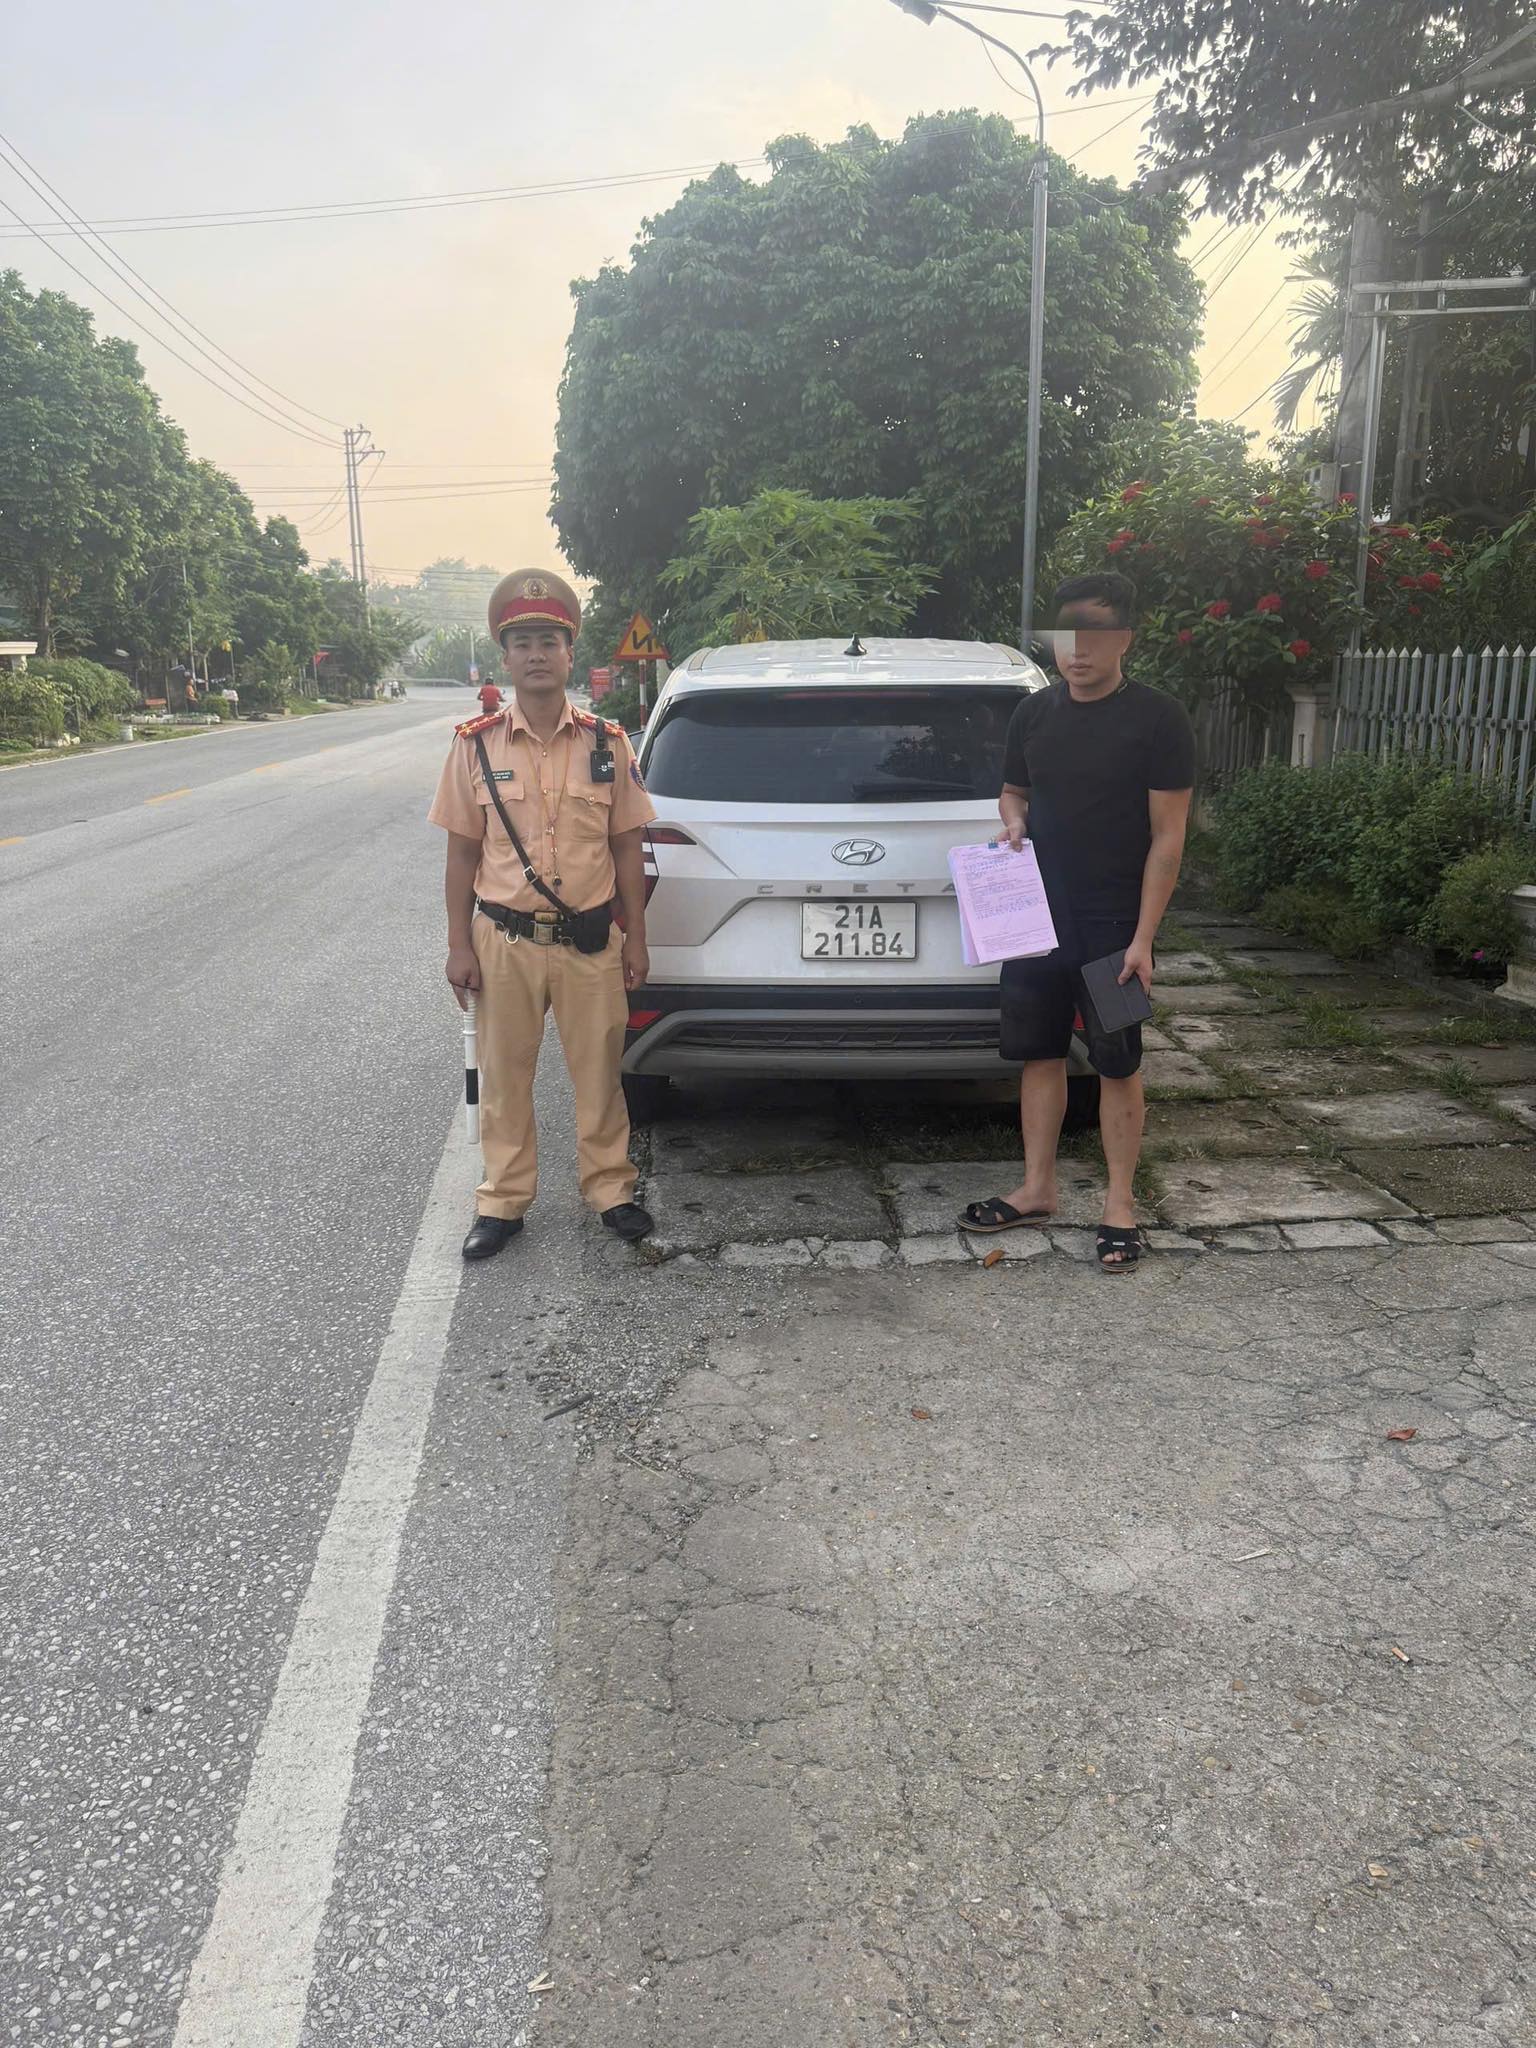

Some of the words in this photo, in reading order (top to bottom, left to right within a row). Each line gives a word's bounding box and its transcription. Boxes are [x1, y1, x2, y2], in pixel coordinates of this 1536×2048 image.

[757, 882, 957, 895] CRETA
[835, 904, 883, 929] 21A
[814, 932, 903, 956] 211.84
